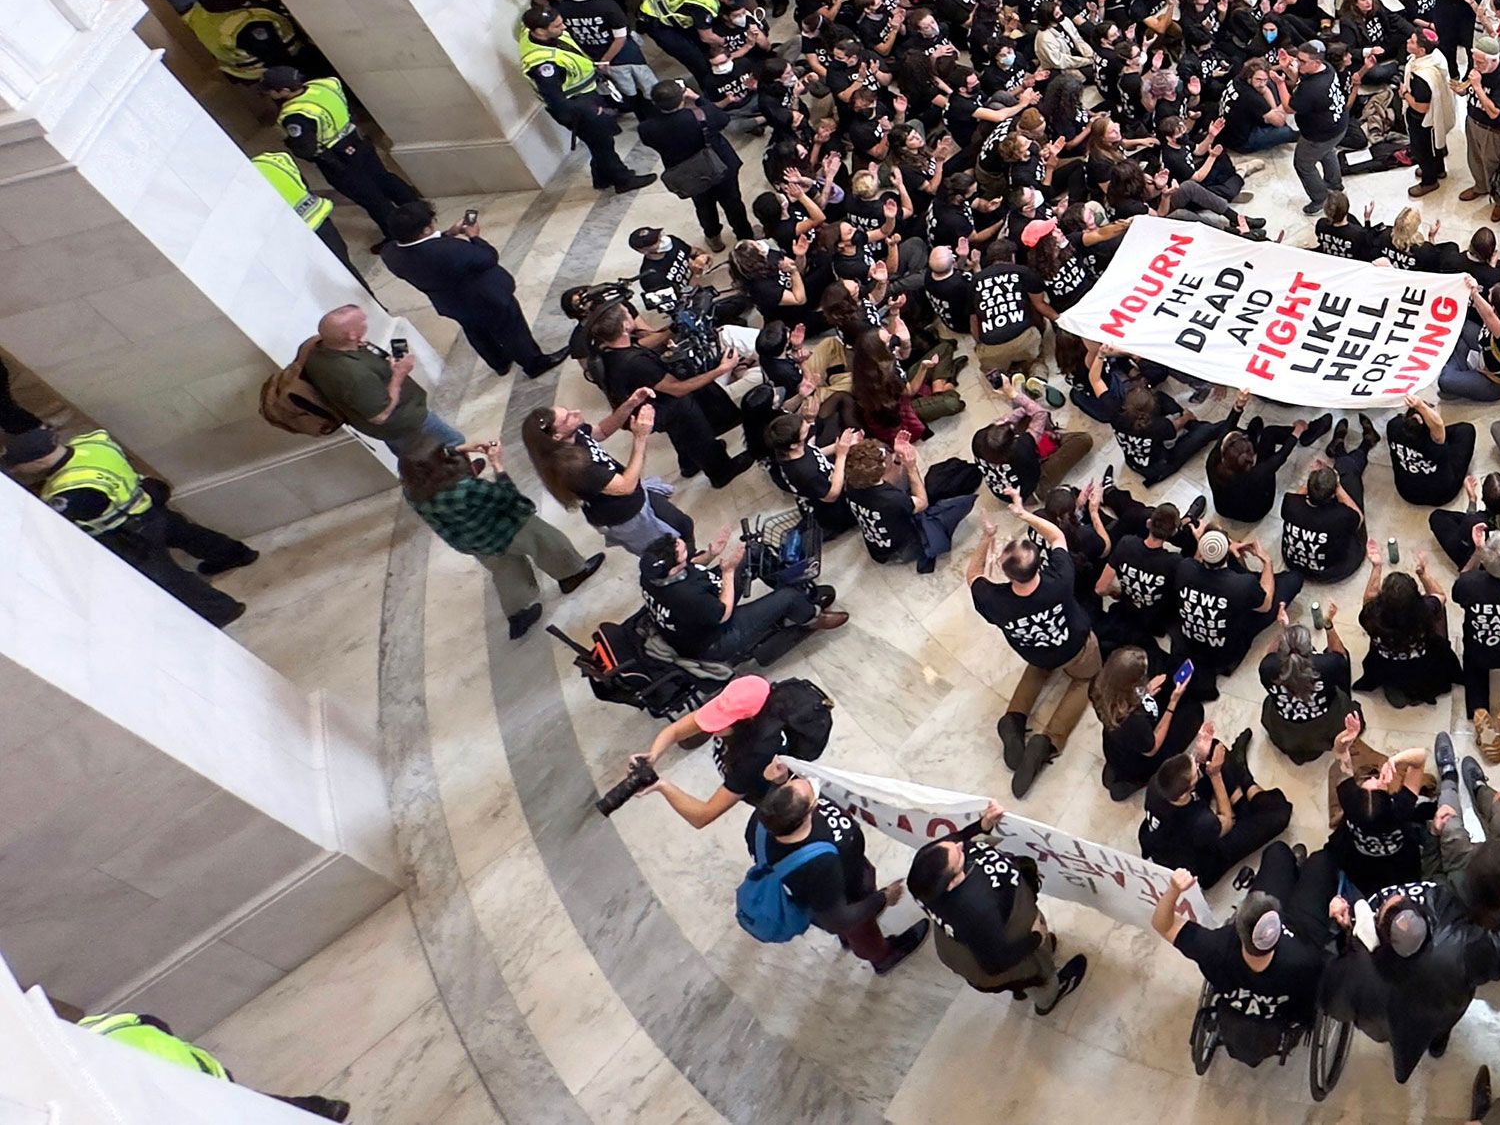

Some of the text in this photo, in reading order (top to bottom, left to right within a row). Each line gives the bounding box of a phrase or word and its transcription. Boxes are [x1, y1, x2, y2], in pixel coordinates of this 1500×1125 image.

[718, 73, 750, 94] NOT IN
[666, 249, 686, 282] NOT IN
[1066, 256, 1078, 268] IN
[1380, 247, 1417, 267] JEWS
[975, 273, 1020, 292] JEWS
[1054, 267, 1078, 289] OUR
[1100, 233, 1194, 338] MOURN
[978, 293, 1022, 311] CEASE
[981, 283, 1015, 299] SAY
[1153, 273, 1204, 319] THE
[986, 303, 1018, 318] FIRE
[1175, 261, 1254, 353] DEAD,
[1227, 289, 1274, 347] AND
[981, 311, 1025, 333] NOW
[1246, 271, 1322, 381] FIGHT
[1290, 291, 1352, 374] LIKE
[1322, 297, 1390, 382] HELL
[1351, 285, 1427, 397] FOR THE
[1382, 295, 1458, 396] LIVING
[1284, 522, 1328, 543] JEWS
[1120, 562, 1166, 587] JEWS
[1179, 585, 1228, 609] JEWS
[1183, 599, 1220, 619] SAY
[1005, 603, 1063, 631] JEWS
[1179, 609, 1227, 629] CEASE
[1184, 620, 1218, 637] FIRE
[1180, 625, 1226, 648] NOW
[820, 809, 842, 841] NOT
[975, 857, 1000, 888] NOT
